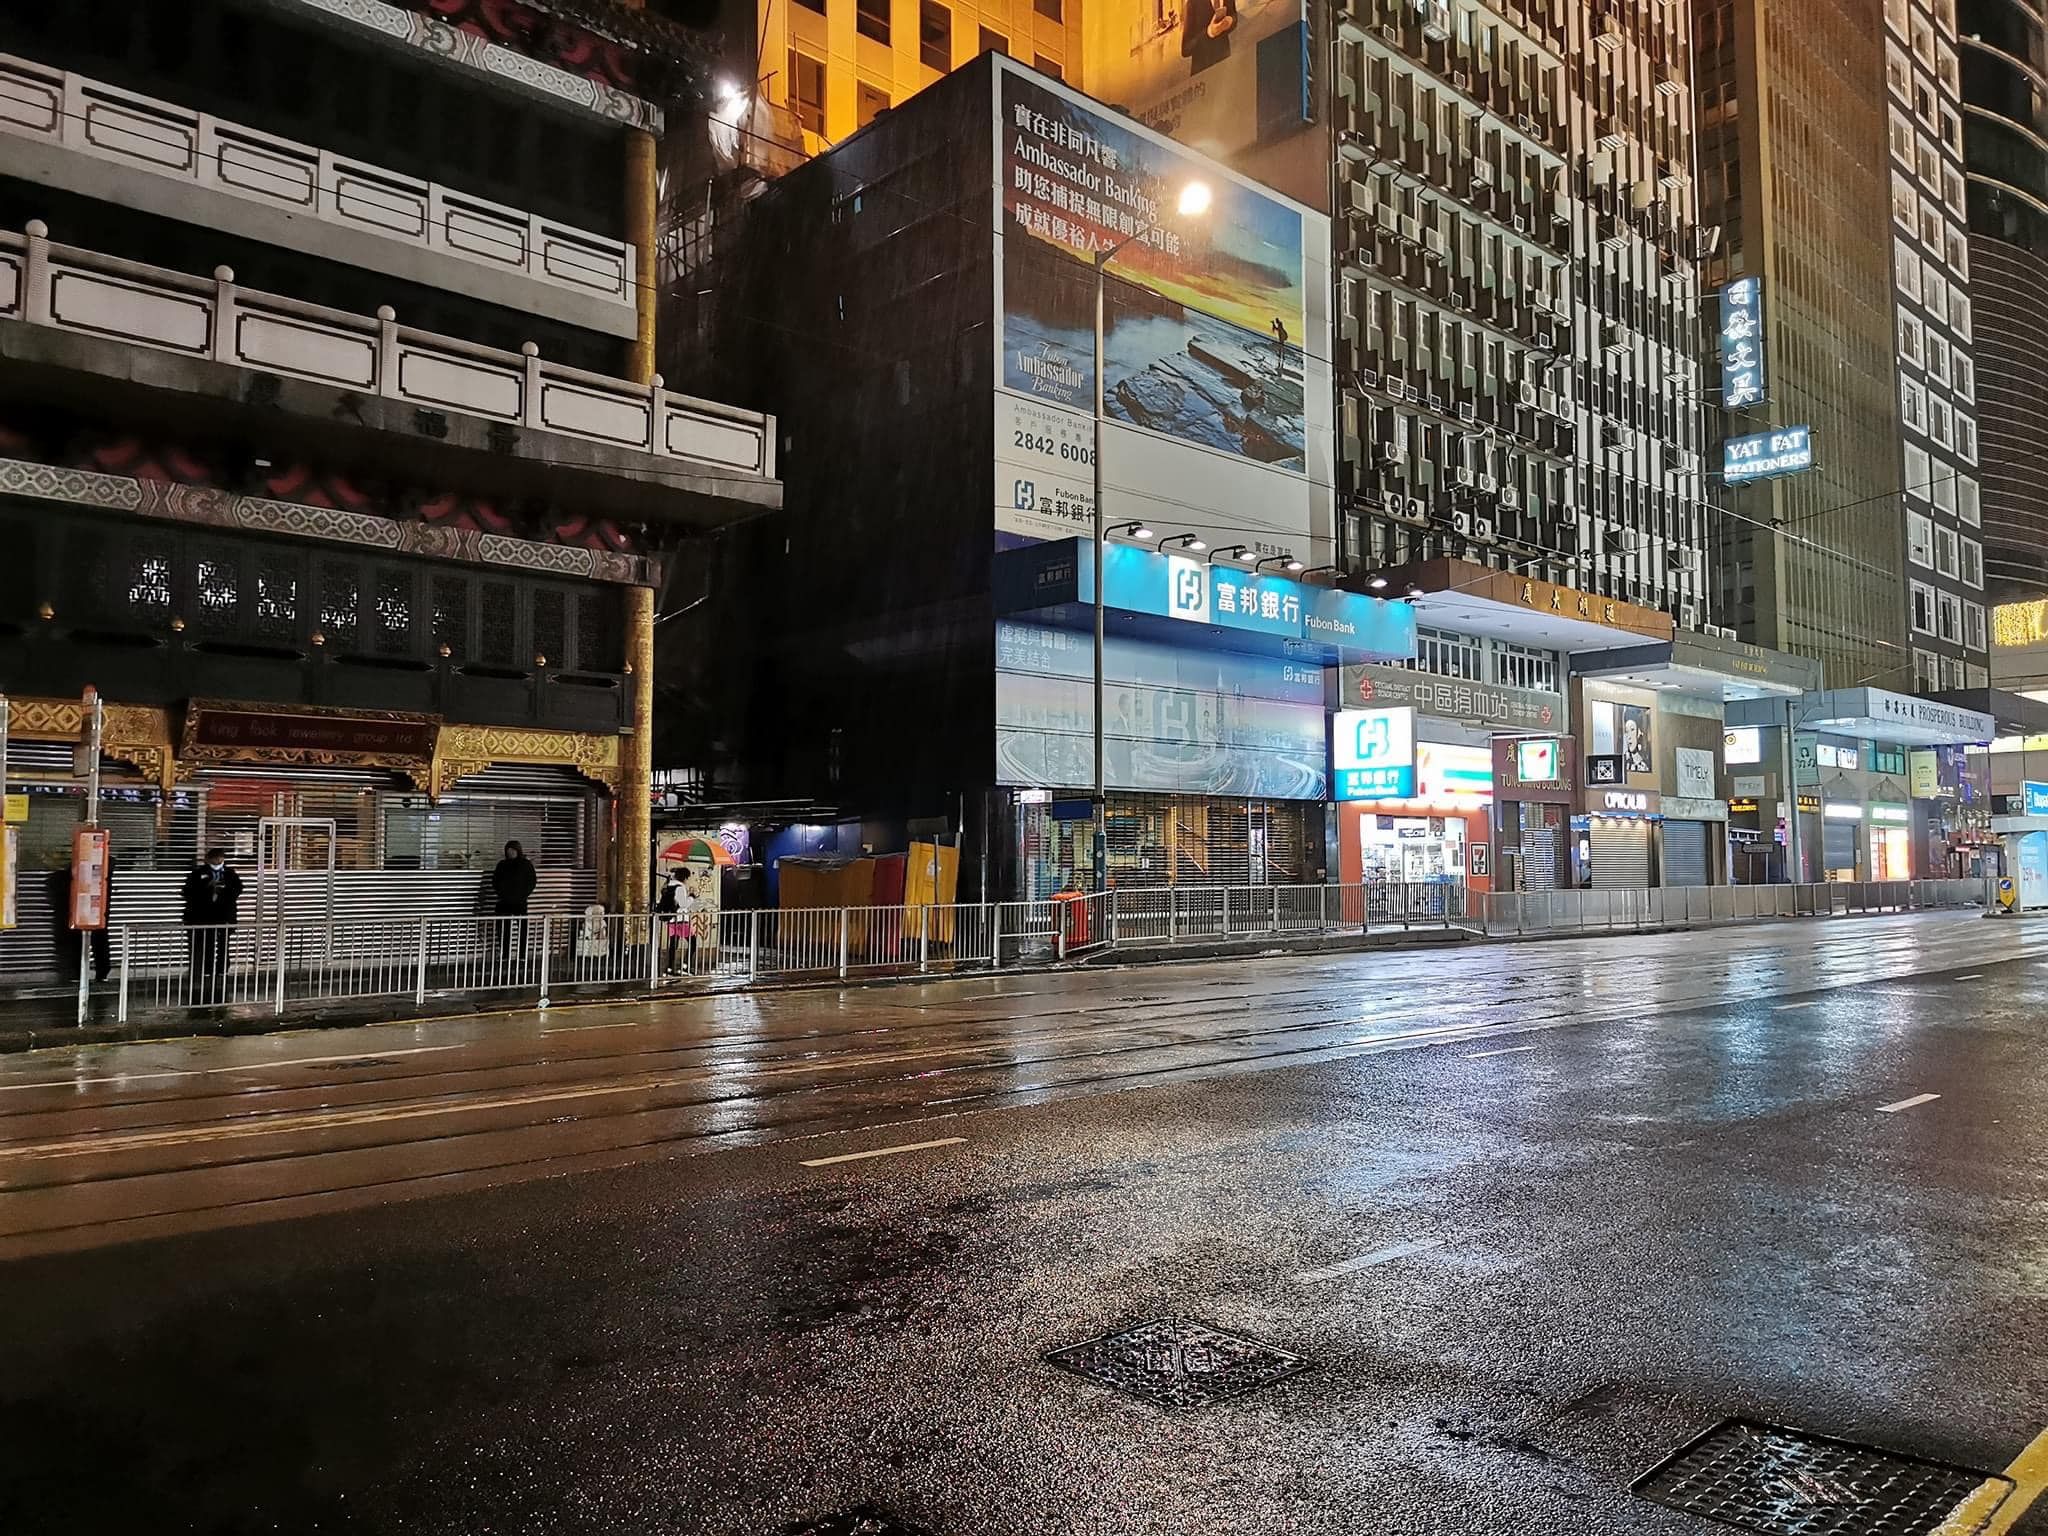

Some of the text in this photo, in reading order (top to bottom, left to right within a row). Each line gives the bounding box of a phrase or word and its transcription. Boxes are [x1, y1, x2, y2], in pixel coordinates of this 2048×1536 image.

[1014, 103, 1118, 170] 實在非同凡響
[1014, 134, 1158, 224] Ambassador Banking
[1015, 351, 1084, 389] Ambassador
[1031, 376, 1073, 401] Banking
[1014, 403, 1064, 424] Ambassador
[1014, 430, 1096, 466] 2842 6008
[1727, 432, 1805, 460] YAT FAT
[1055, 488, 1095, 505] Fubon Ban
[1216, 582, 1299, 624] 富邦銀行
[1304, 614, 1356, 635] Fubon Bank
[1919, 704, 1955, 728] PROSPEROUS
[1959, 713, 1984, 733] BUILDING
